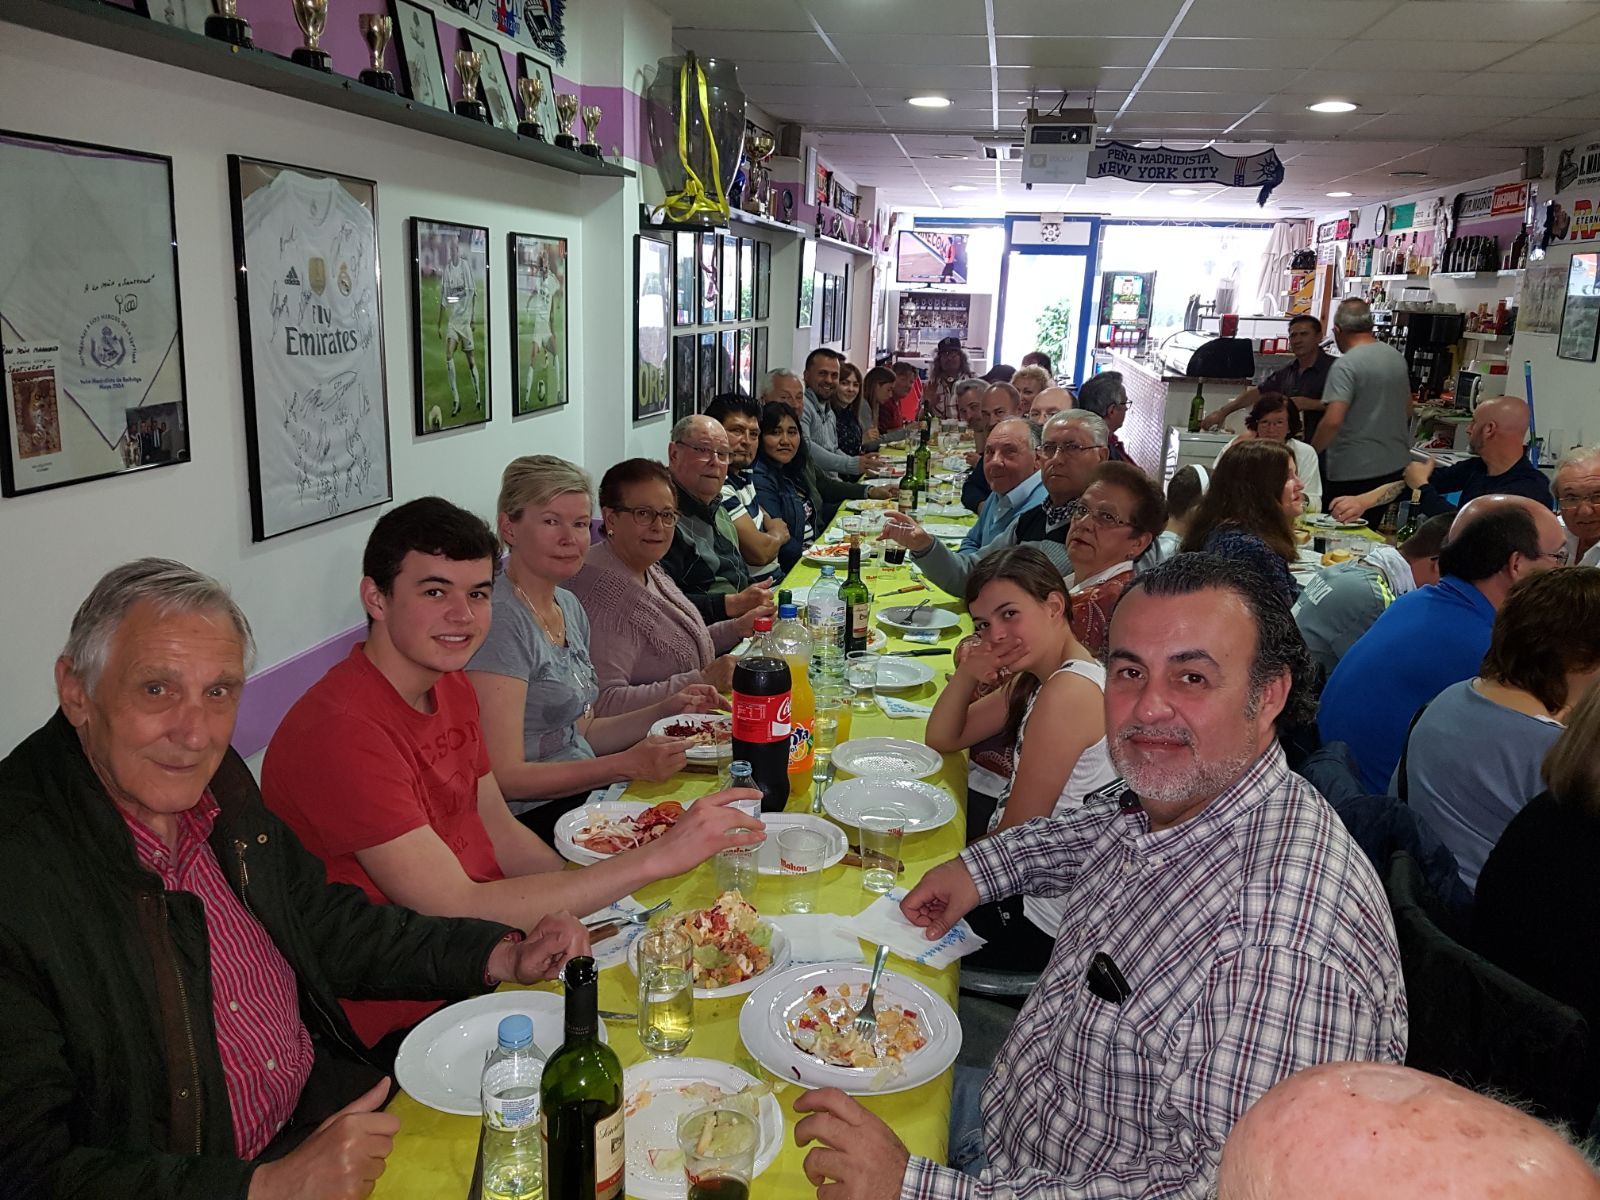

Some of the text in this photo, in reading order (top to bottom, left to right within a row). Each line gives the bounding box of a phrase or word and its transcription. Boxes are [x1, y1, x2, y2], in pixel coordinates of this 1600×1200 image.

[1107, 148, 1211, 165] PEÑA MADRIDISTA
[1098, 163, 1219, 179] NEW YORK CITY
[1576, 215, 1600, 225] ETERN
[285, 326, 358, 355] Emirates
[780, 857, 808, 873] Mahou
